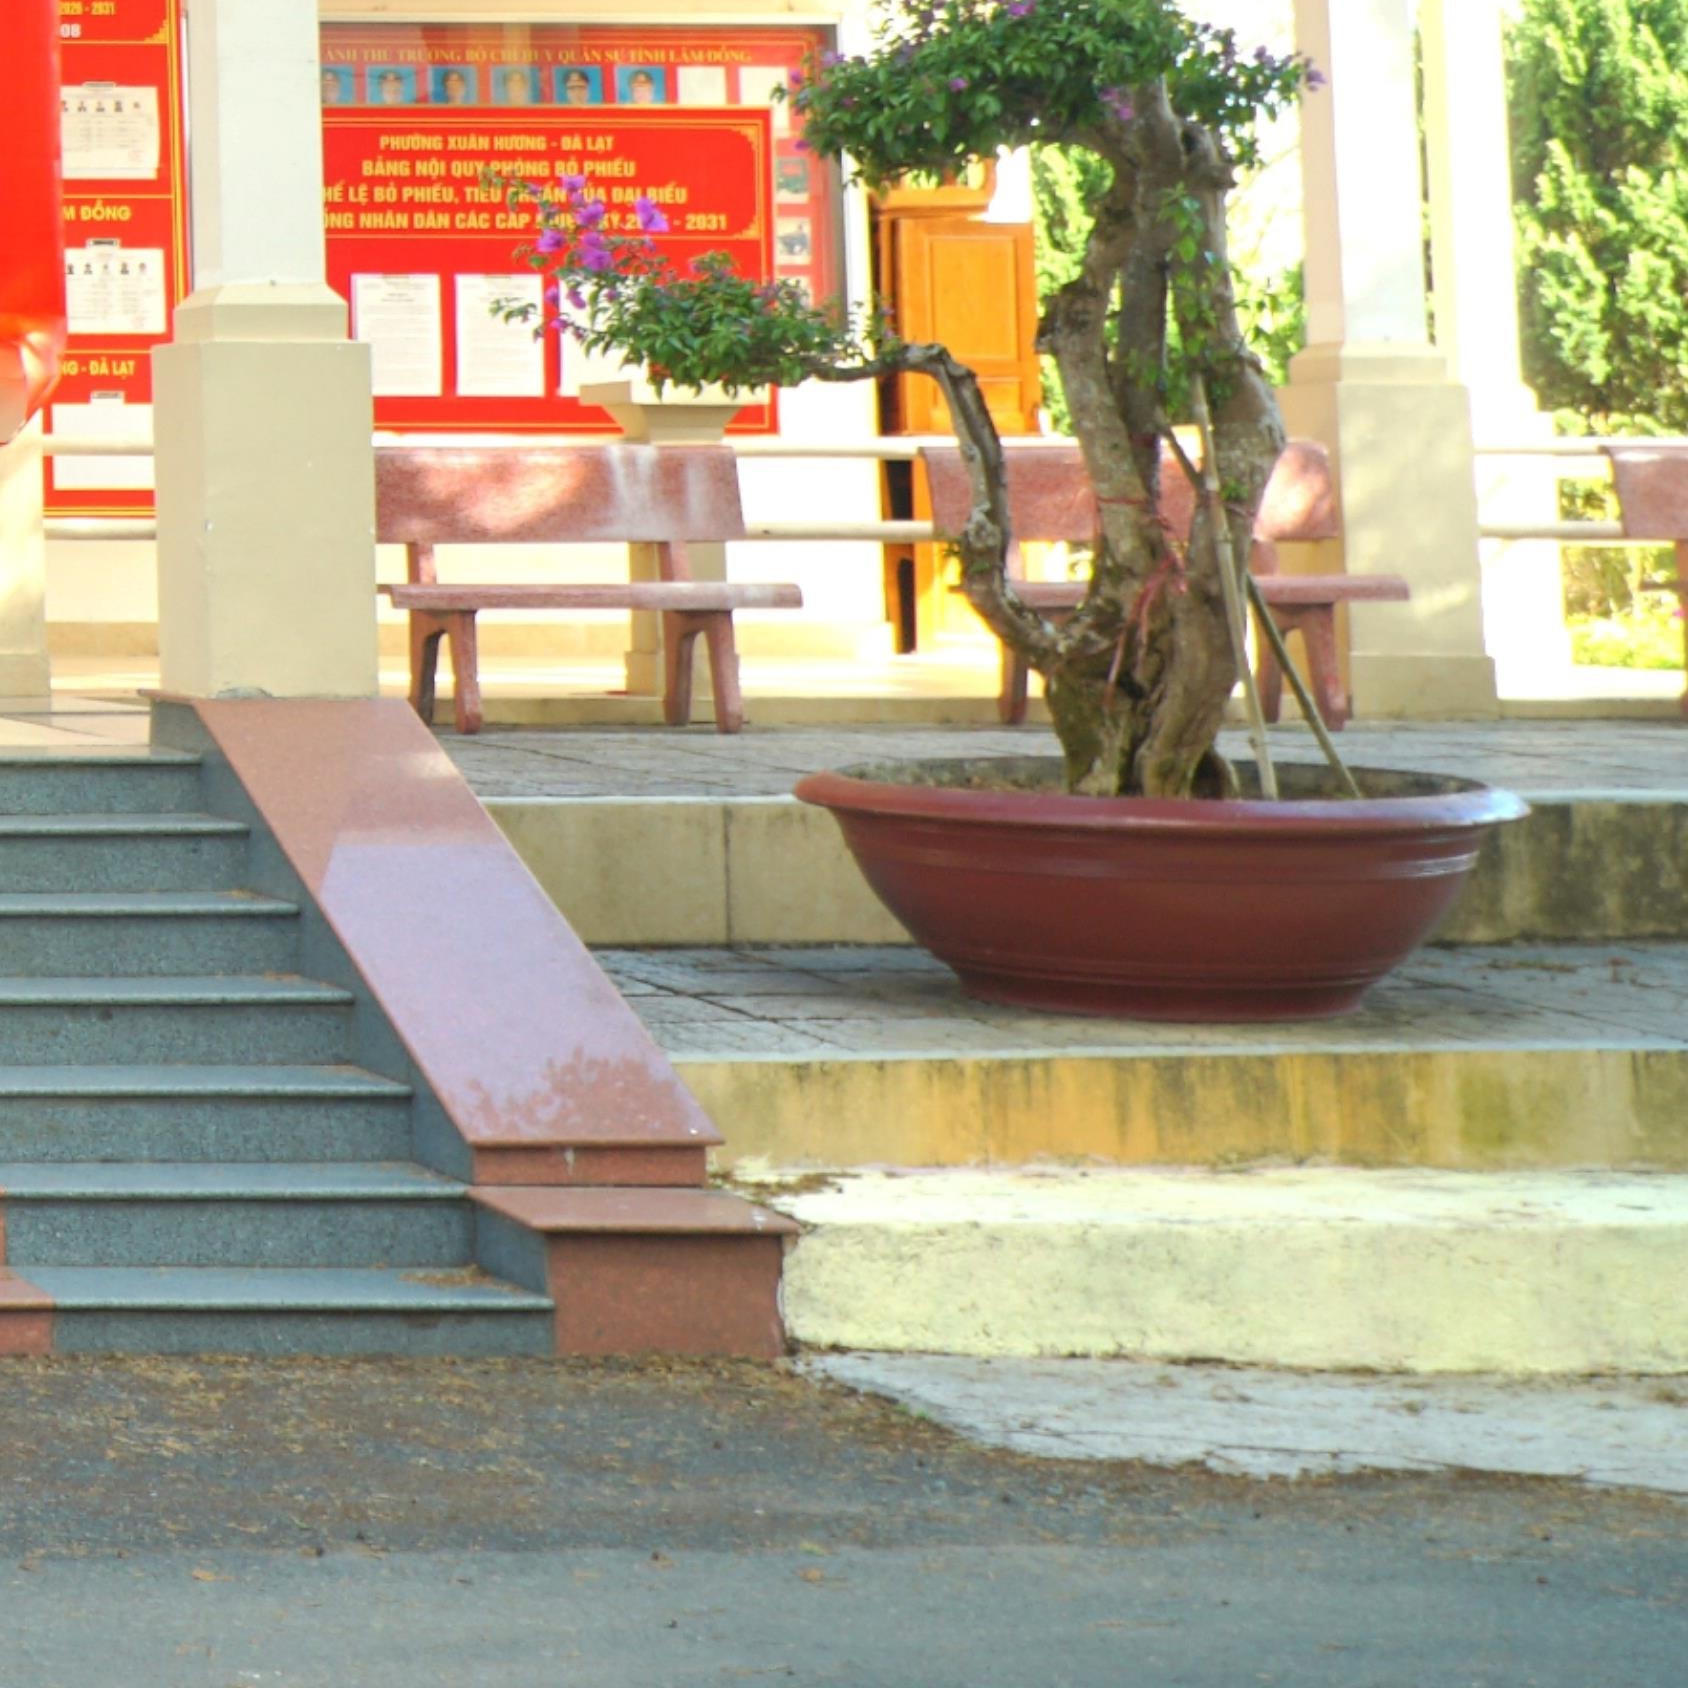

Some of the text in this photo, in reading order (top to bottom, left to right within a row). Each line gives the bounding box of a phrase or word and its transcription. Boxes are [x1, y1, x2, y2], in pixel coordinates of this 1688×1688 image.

[380, 133, 613, 154] PHƯỜNG XUÂN HƯƠNG ĐÀ LẠT
[361, 155, 410, 177] BẢNG
[415, 157, 446, 179] NỘI
[451, 160, 485, 177] QUY
[554, 156, 579, 177] BỎ
[583, 156, 636, 177] PHIẾU
[348, 183, 368, 206] LỆ
[374, 180, 398, 203] BỎ
[612, 187, 642, 206] ĐẠI
[646, 180, 688, 203] BIỂU
[80, 198, 132, 221] ĐỒNG
[360, 209, 408, 229] NHÂN
[414, 209, 450, 229] DÂN
[455, 209, 490, 229] CÁC
[685, 213, 728, 230] 2031
[113, 360, 135, 379] LẠT
